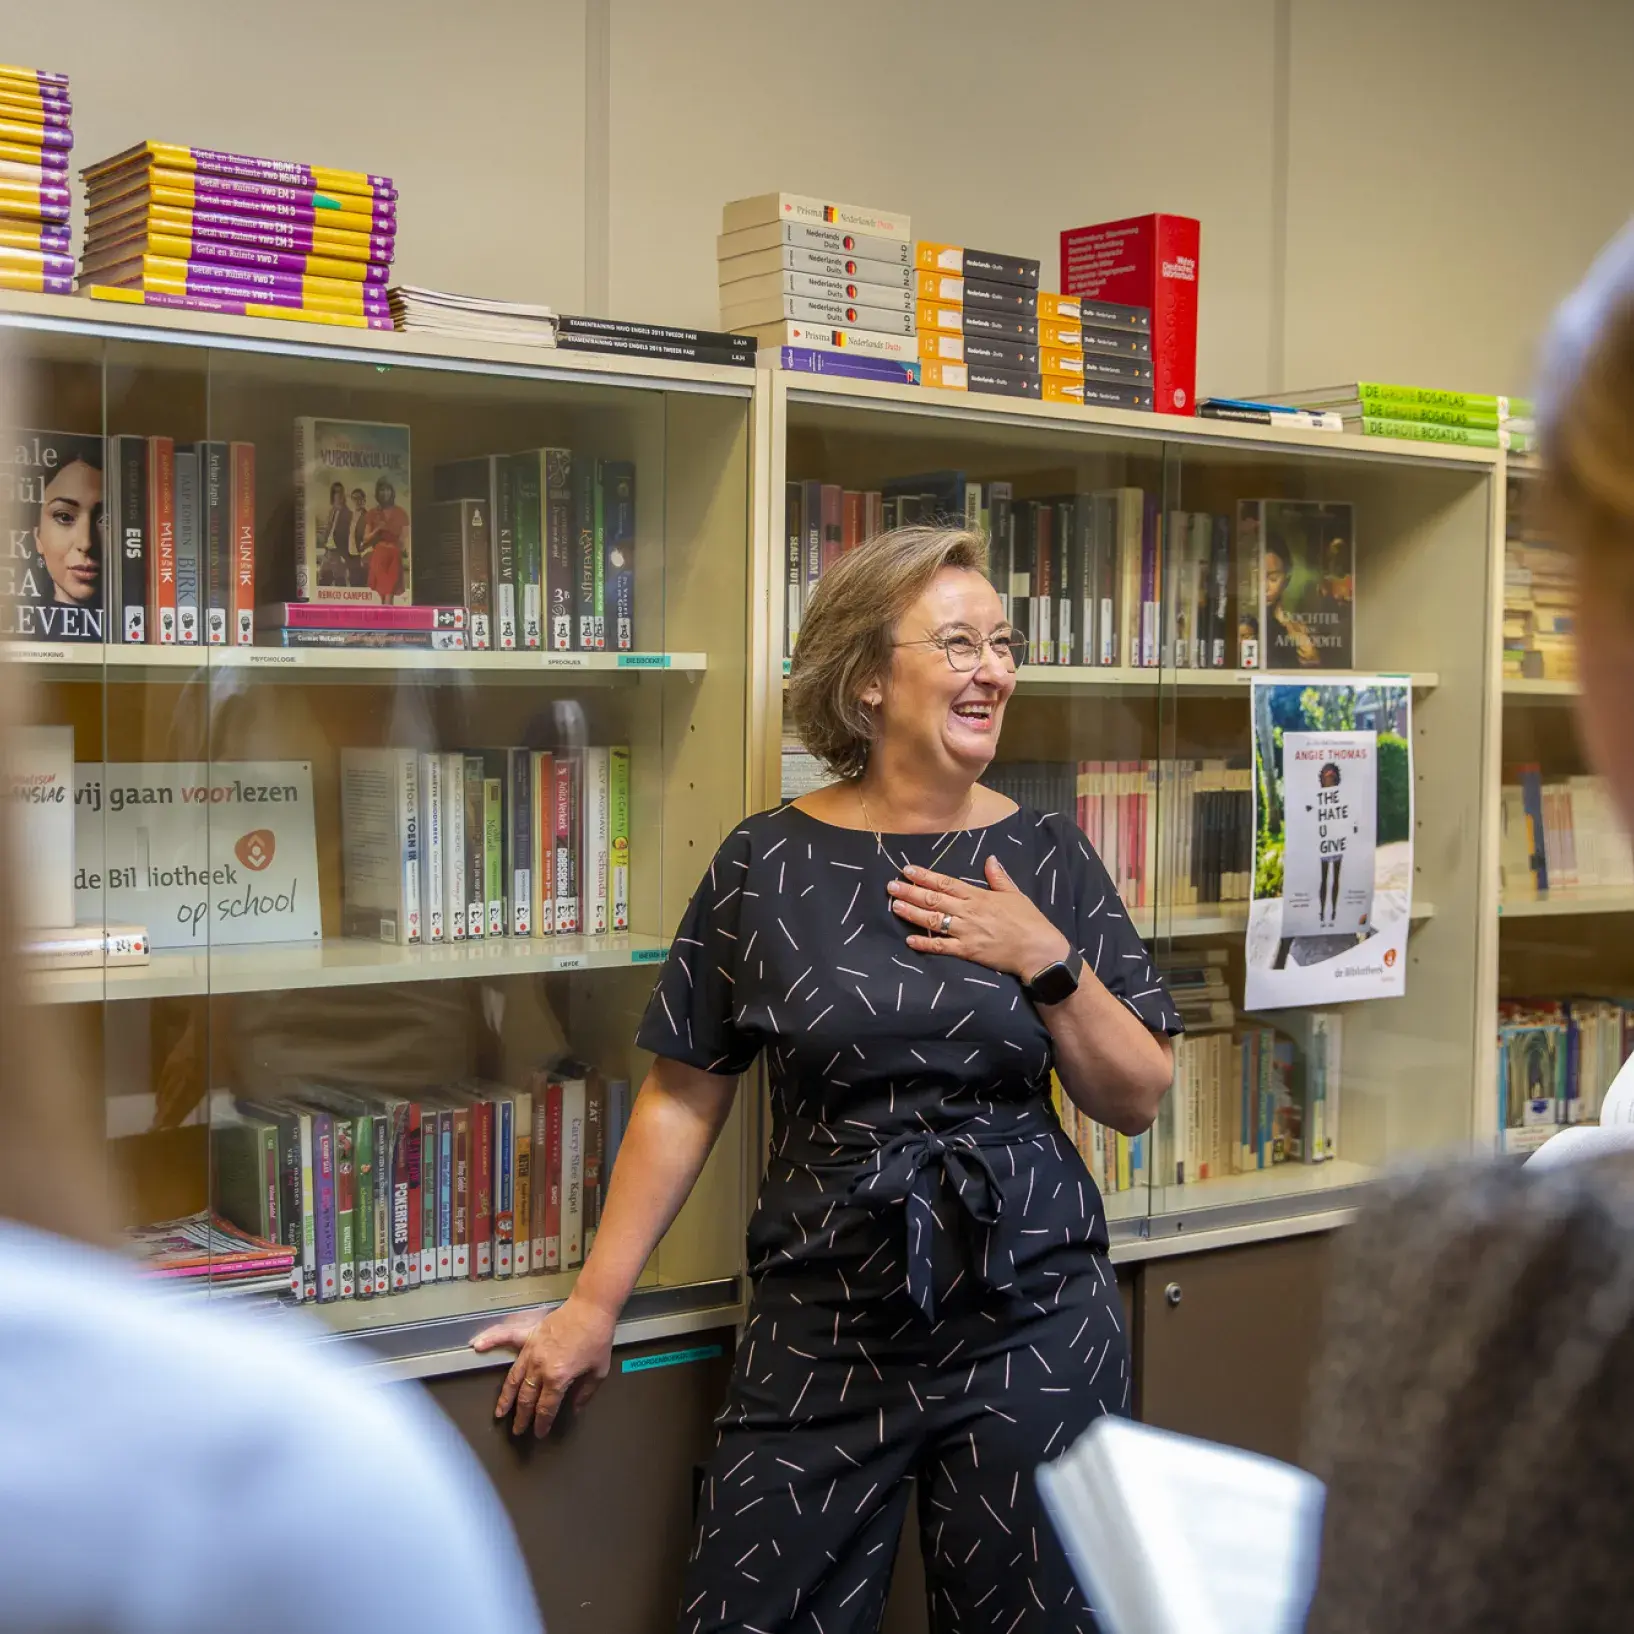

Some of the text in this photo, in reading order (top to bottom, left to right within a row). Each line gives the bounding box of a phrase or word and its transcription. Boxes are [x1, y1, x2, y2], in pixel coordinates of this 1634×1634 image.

[796, 205, 823, 218] Prisma
[806, 228, 840, 241] Nederlands
[196, 244, 216, 256] Getal
[218, 248, 227, 256] en
[229, 249, 255, 261] Ruimte
[272, 254, 278, 264] 2
[824, 241, 840, 250] Duits
[808, 254, 842, 266] Nederlands
[826, 266, 842, 275] Duits
[269, 275, 275, 284] 2
[808, 278, 842, 290] Nederlands
[808, 302, 842, 314] Nederlands
[805, 330, 830, 342] Prisma
[848, 336, 884, 349] Nederlands
[1365, 385, 1379, 398] DE
[1370, 404, 1382, 416] DE
[1370, 421, 1384, 434] DE
[210, 452, 220, 482] Arthur
[126, 527, 142, 559] EUS
[500, 528, 512, 580] KIEUW
[177, 556, 196, 601] BIRK
[1294, 748, 1368, 762] ANGIE THOMAS
[406, 762, 414, 779] Isa
[109, 785, 174, 812] gaan
[180, 780, 299, 804] voorlezen
[405, 782, 416, 813] Hoes
[1316, 790, 1340, 806] THE
[618, 788, 626, 833] McCarthy
[1318, 806, 1348, 822] HATE
[408, 816, 417, 848] TOEN
[556, 780, 568, 896] Anita Verkerk Cheesecake
[1319, 825, 1328, 838] U
[1320, 838, 1347, 854] GIVE
[74, 868, 102, 890] de
[598, 850, 607, 898] Schandal
[176, 878, 298, 938] op school
[560, 960, 580, 968] LIEFDE
[588, 1100, 598, 1123] ZAT
[568, 1118, 580, 1214] Carry Slee Kapot
[394, 1182, 408, 1244] POKERFACE
